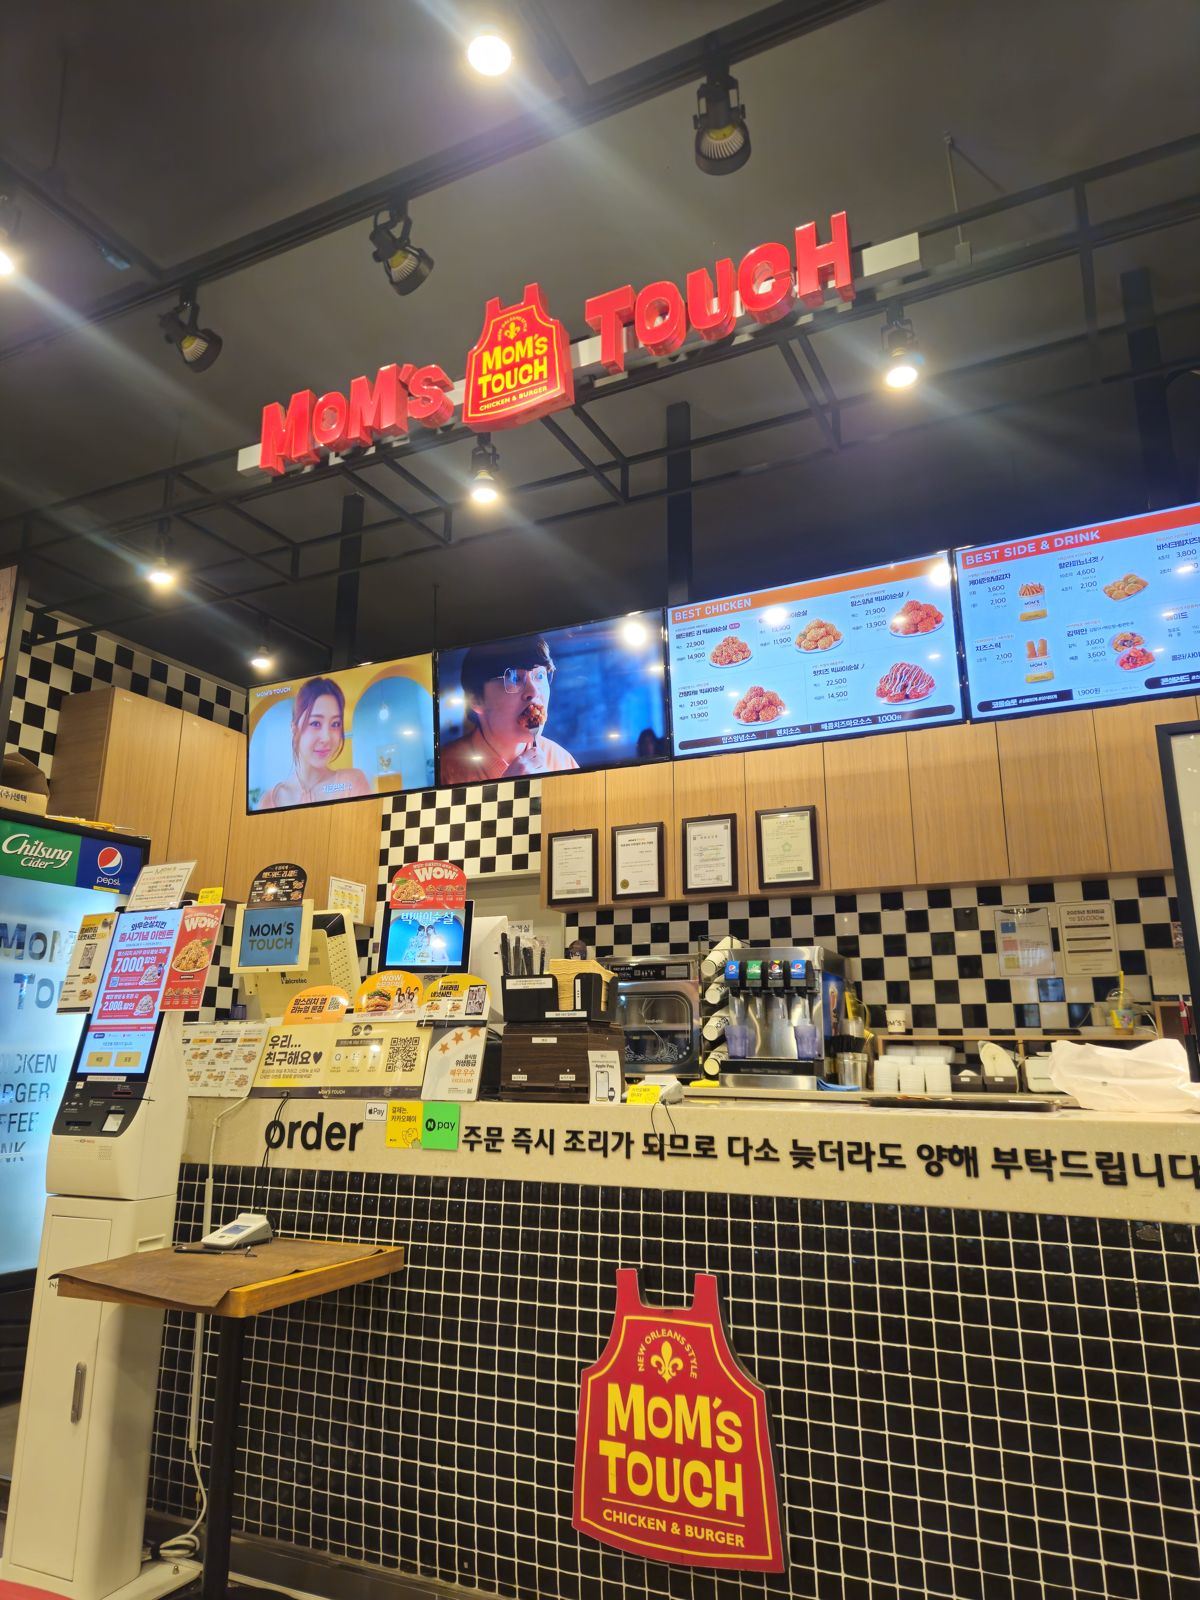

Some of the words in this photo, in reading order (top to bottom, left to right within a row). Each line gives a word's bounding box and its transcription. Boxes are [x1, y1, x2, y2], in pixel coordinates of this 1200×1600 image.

[585, 211, 855, 374] TOUCH
[478, 356, 549, 398] TOUCH
[479, 397, 511, 411] CHICKEN
[518, 385, 548, 399] BURGER
[965, 549, 1000, 566] BEST
[1004, 542, 1036, 558] SIDE
[1040, 540, 1050, 551] &
[1054, 530, 1101, 547] DRINK
[1177, 549, 1197, 557] 3,800
[1077, 568, 1096, 576] 4,600
[675, 608, 702, 620] BEST
[704, 598, 752, 615] CHICKEN
[865, 607, 886, 615] 21,900
[866, 620, 887, 628] 13,900
[976, 642, 1001, 651] 치즈스틱
[687, 652, 706, 660] 14,900
[826, 678, 847, 686] 22,500
[828, 691, 848, 699] 14,500
[690, 699, 708, 707] 21,900
[1, 833, 73, 868] Chilsung
[20, 857, 55, 869] Cider
[96, 876, 121, 886] pepsi
[400, 911, 455, 925] 빅싸이순살
[150, 930, 175, 940] 이벤트
[249, 922, 295, 937] MOM'S
[249, 938, 293, 951] TOUCH
[14, 973, 64, 1010] TO
[294, 998, 319, 1006] 맘스터치
[290, 1006, 310, 1014] 리뉴얼
[269, 1034, 301, 1049] 우리...
[264, 1051, 311, 1066] 친구해요
[463, 1068, 475, 1076] 우수
[373, 1108, 385, 1116] Pay
[265, 1112, 364, 1151] order
[437, 1121, 455, 1131] pay
[462, 1126, 505, 1152] 주문
[511, 1128, 555, 1155] 즉시
[564, 1130, 635, 1159] 조리가
[642, 1133, 718, 1161] 되므로
[728, 1137, 780, 1166] 다소
[789, 1139, 907, 1173] 늦더라도
[916, 1144, 980, 1178] 양해
[991, 1148, 1200, 1189] 부탁드립니다
[637, 1345, 647, 1372] NEW
[645, 1328, 687, 1345] ORLEANS
[684, 1343, 698, 1379] STYLE
[607, 1382, 743, 1453] MOM'S
[599, 1440, 745, 1518] TOUCH
[603, 1508, 667, 1533] CHICKEN
[670, 1521, 681, 1535] &
[684, 1525, 745, 1548] BURGER
